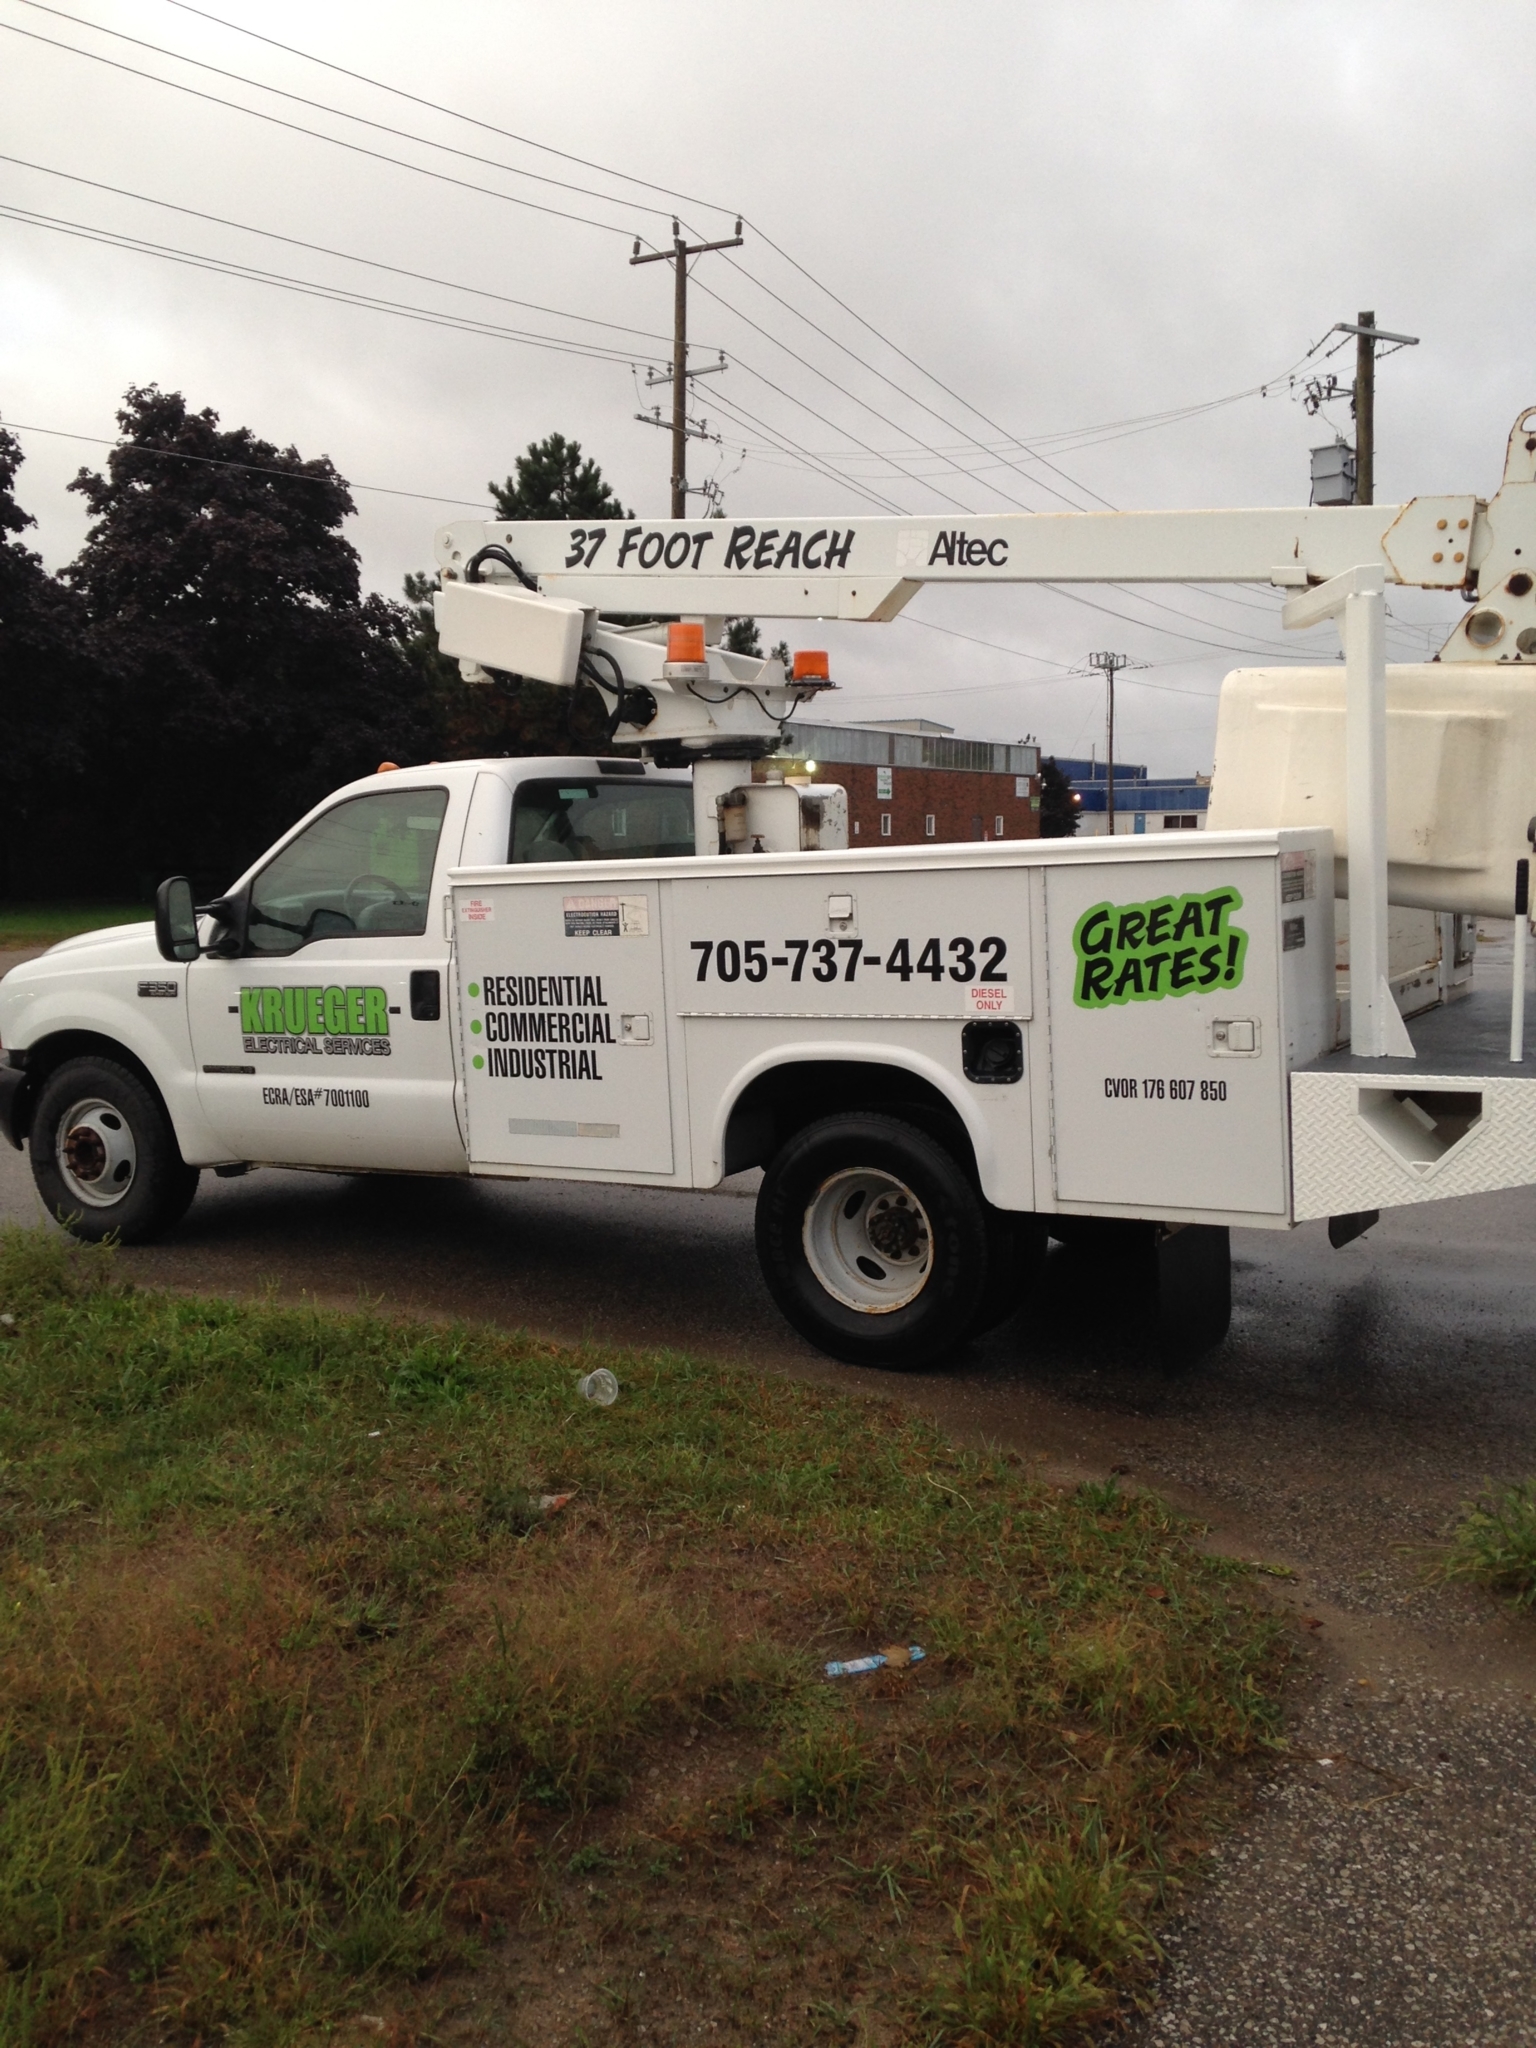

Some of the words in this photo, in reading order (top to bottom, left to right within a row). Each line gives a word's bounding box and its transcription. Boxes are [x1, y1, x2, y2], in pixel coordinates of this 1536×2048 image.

[565, 528, 607, 569] 37
[616, 525, 714, 570] FOOT
[723, 525, 856, 570] REACH
[928, 531, 1009, 566] Altec
[1080, 894, 1234, 955] GREAT
[690, 937, 1008, 983] 705-737-4432
[1081, 935, 1240, 1001] RATES!
[483, 976, 607, 1006] RESIDENTIAL
[971, 988, 1008, 998] DIESEL
[976, 1000, 1003, 1010] ONLY
[240, 986, 390, 1036] KRUEGER
[485, 1012, 617, 1044] COMMERCIAL
[242, 1037, 323, 1054] ELECTRICAL
[323, 1038, 391, 1056] SERVICES
[488, 1048, 603, 1080] INDUSTRIAL
[1104, 1078, 1138, 1099] CVOR
[1142, 1079, 1165, 1100] 176
[1169, 1079, 1195, 1100] 607
[1200, 1080, 1227, 1102] 850
